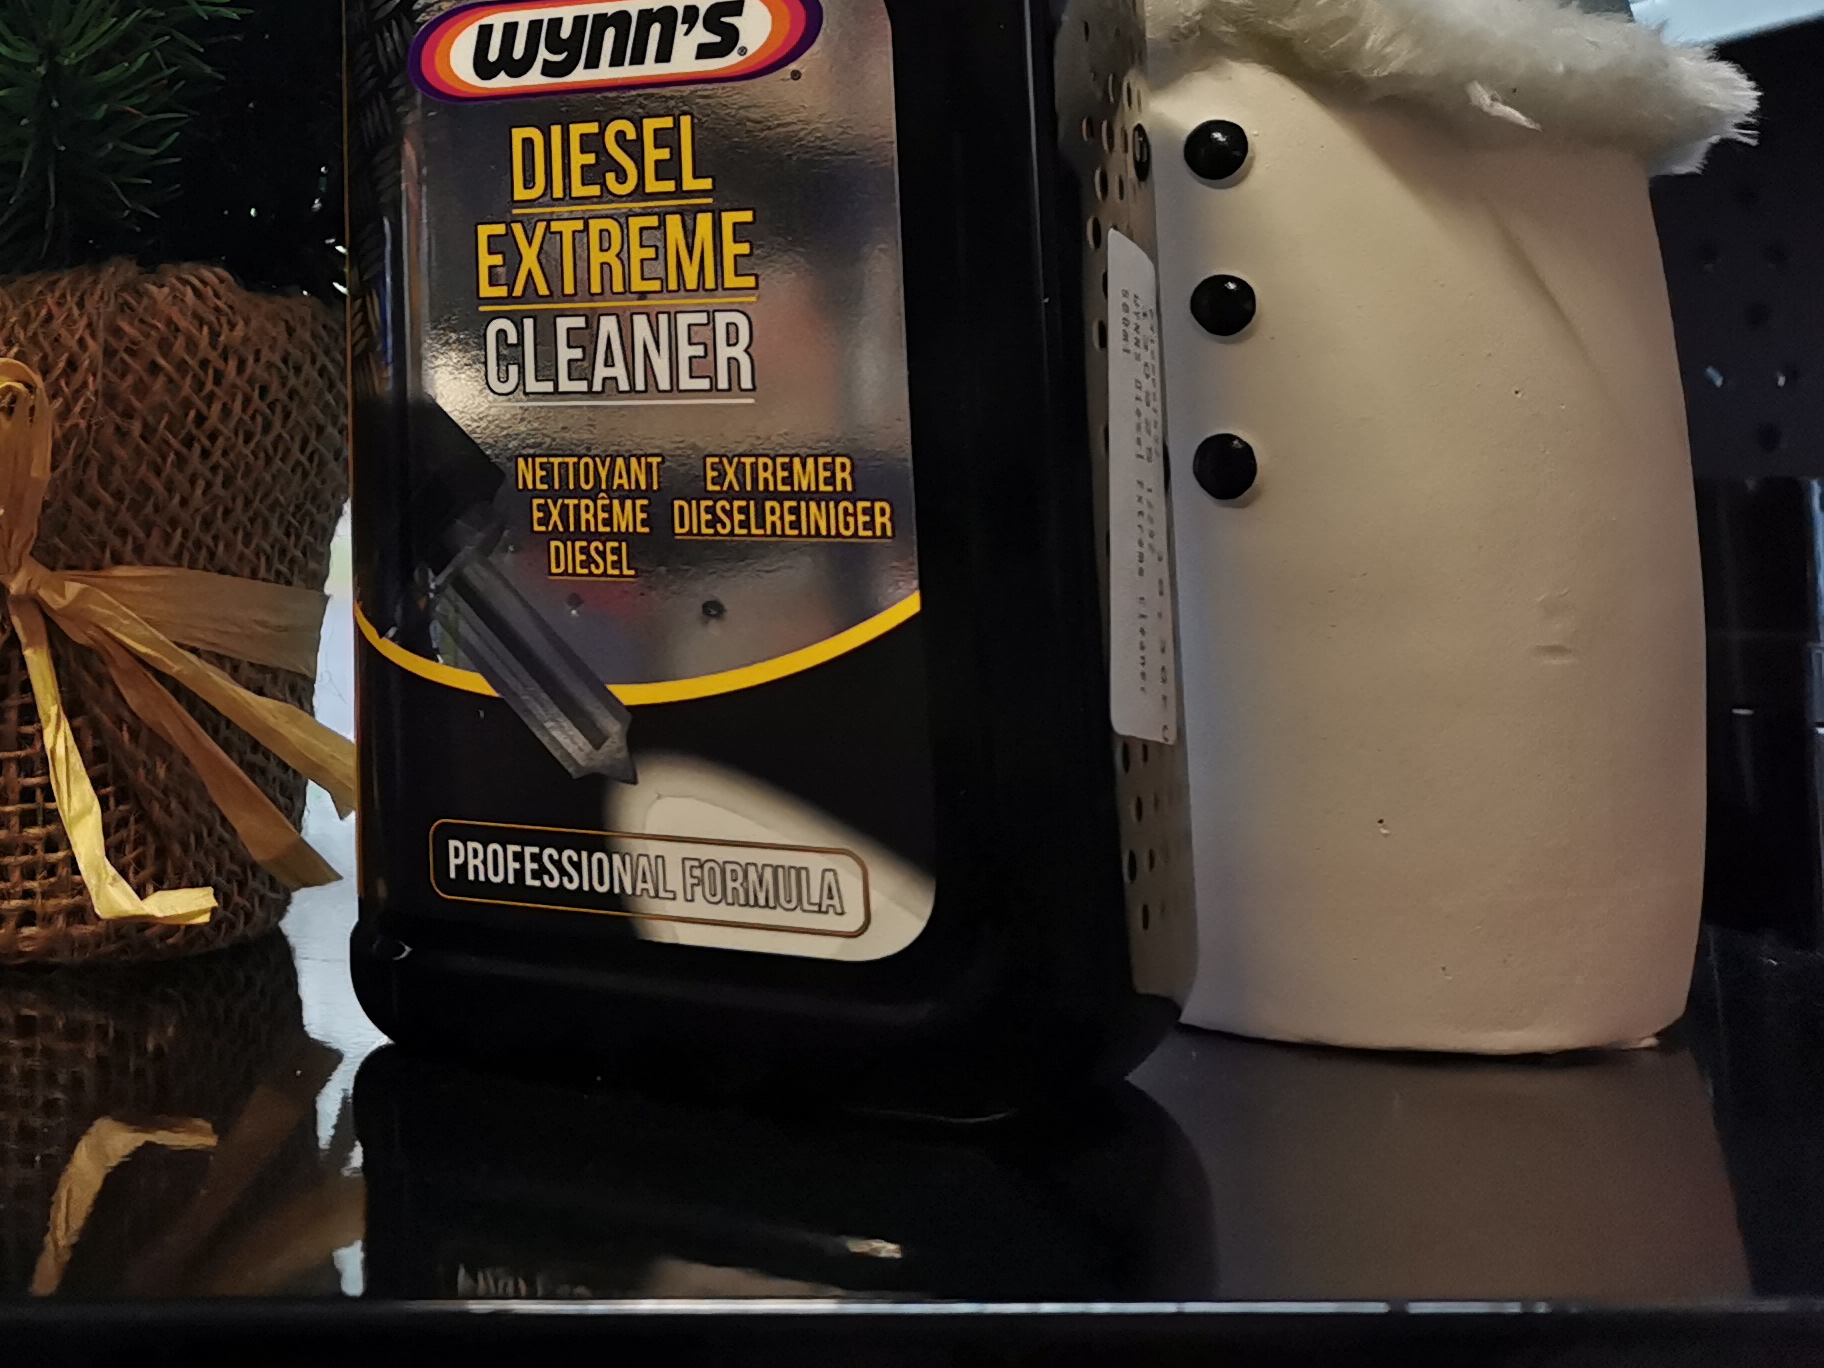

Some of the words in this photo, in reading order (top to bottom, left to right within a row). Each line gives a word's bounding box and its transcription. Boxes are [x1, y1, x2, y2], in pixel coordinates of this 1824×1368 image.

[510, 114, 714, 202] DIESEL
[476, 208, 760, 301] EXTREME
[485, 309, 756, 397] CLEANER
[516, 455, 663, 491] NETTOYANT
[704, 455, 854, 493] EXTREMER
[531, 493, 651, 533] EXTRÊME
[673, 499, 894, 538] DIESELREINIGER
[549, 540, 636, 577] DIESEL
[447, 838, 676, 901] PROFESSIONAL
[682, 857, 846, 916] FORMULA
